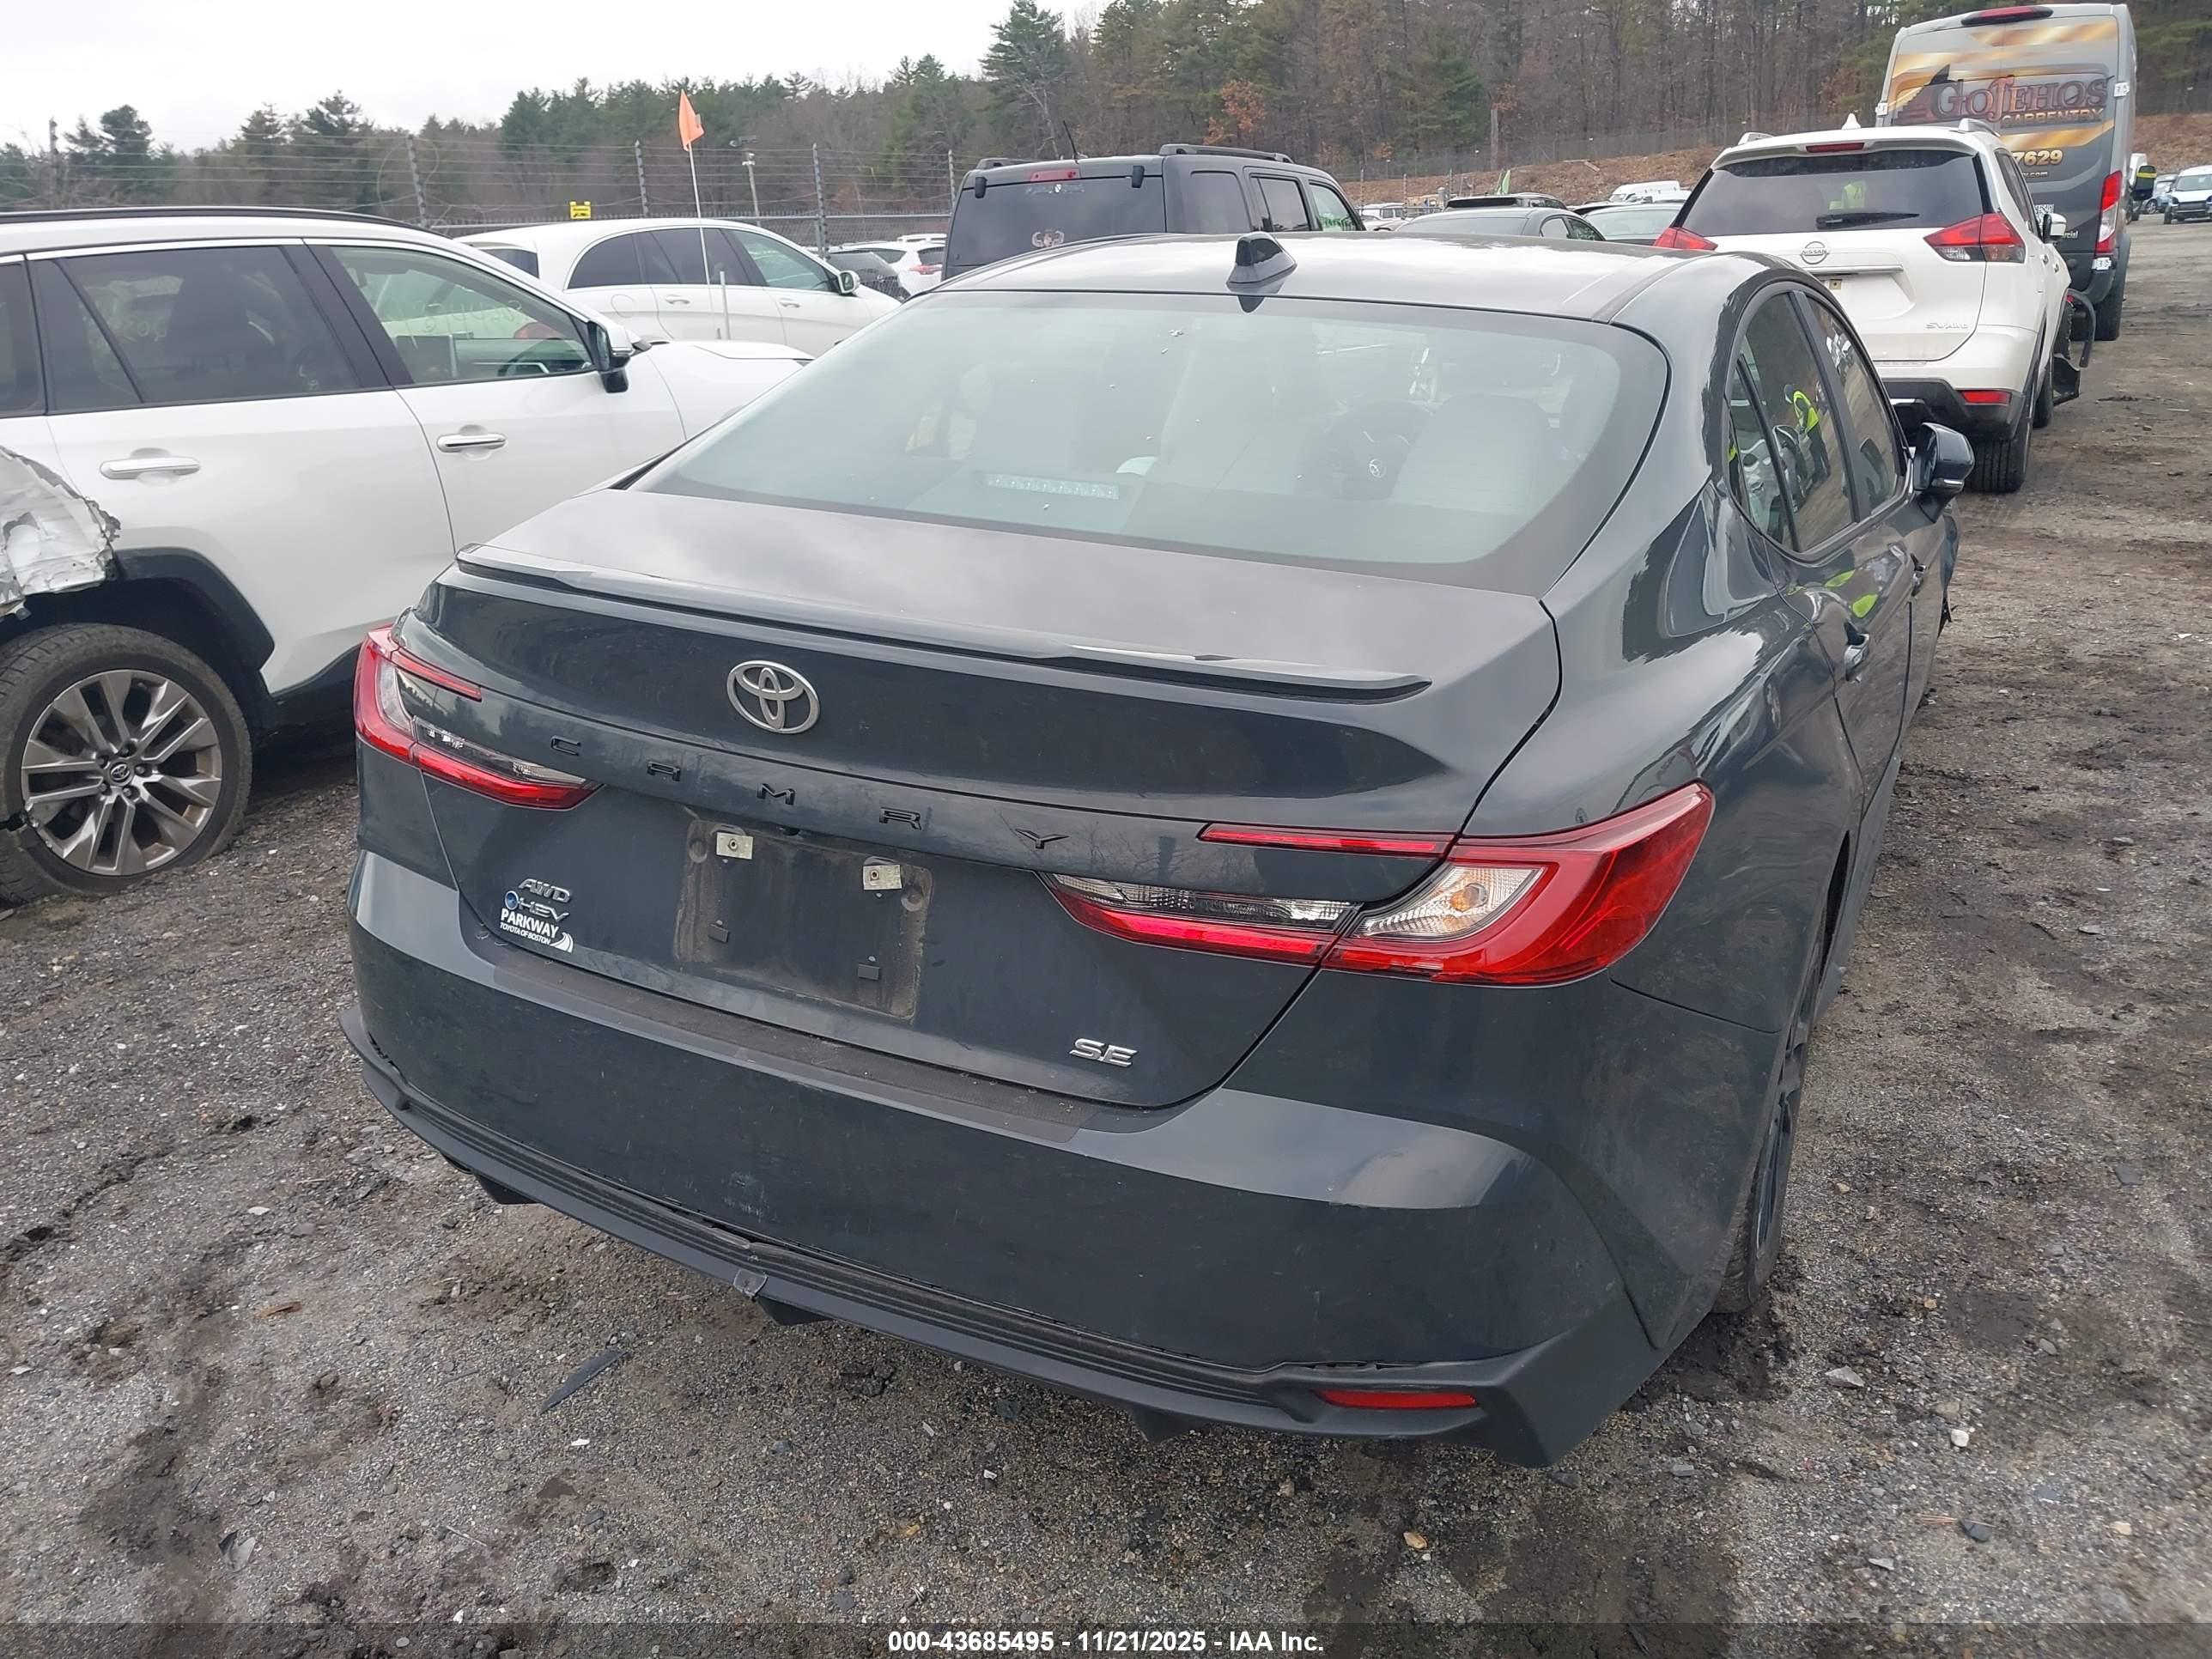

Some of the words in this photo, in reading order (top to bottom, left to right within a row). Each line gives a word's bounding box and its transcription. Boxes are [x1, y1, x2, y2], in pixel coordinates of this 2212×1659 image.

[550, 735, 1070, 849] CAMRY
[519, 878, 570, 902] AWD
[518, 898, 569, 921] HEV
[500, 921, 520, 935] TOYOTA
[528, 931, 552, 945] BOSTON
[501, 908, 559, 939] PARKWAY
[1069, 1038, 1137, 1067] SE
